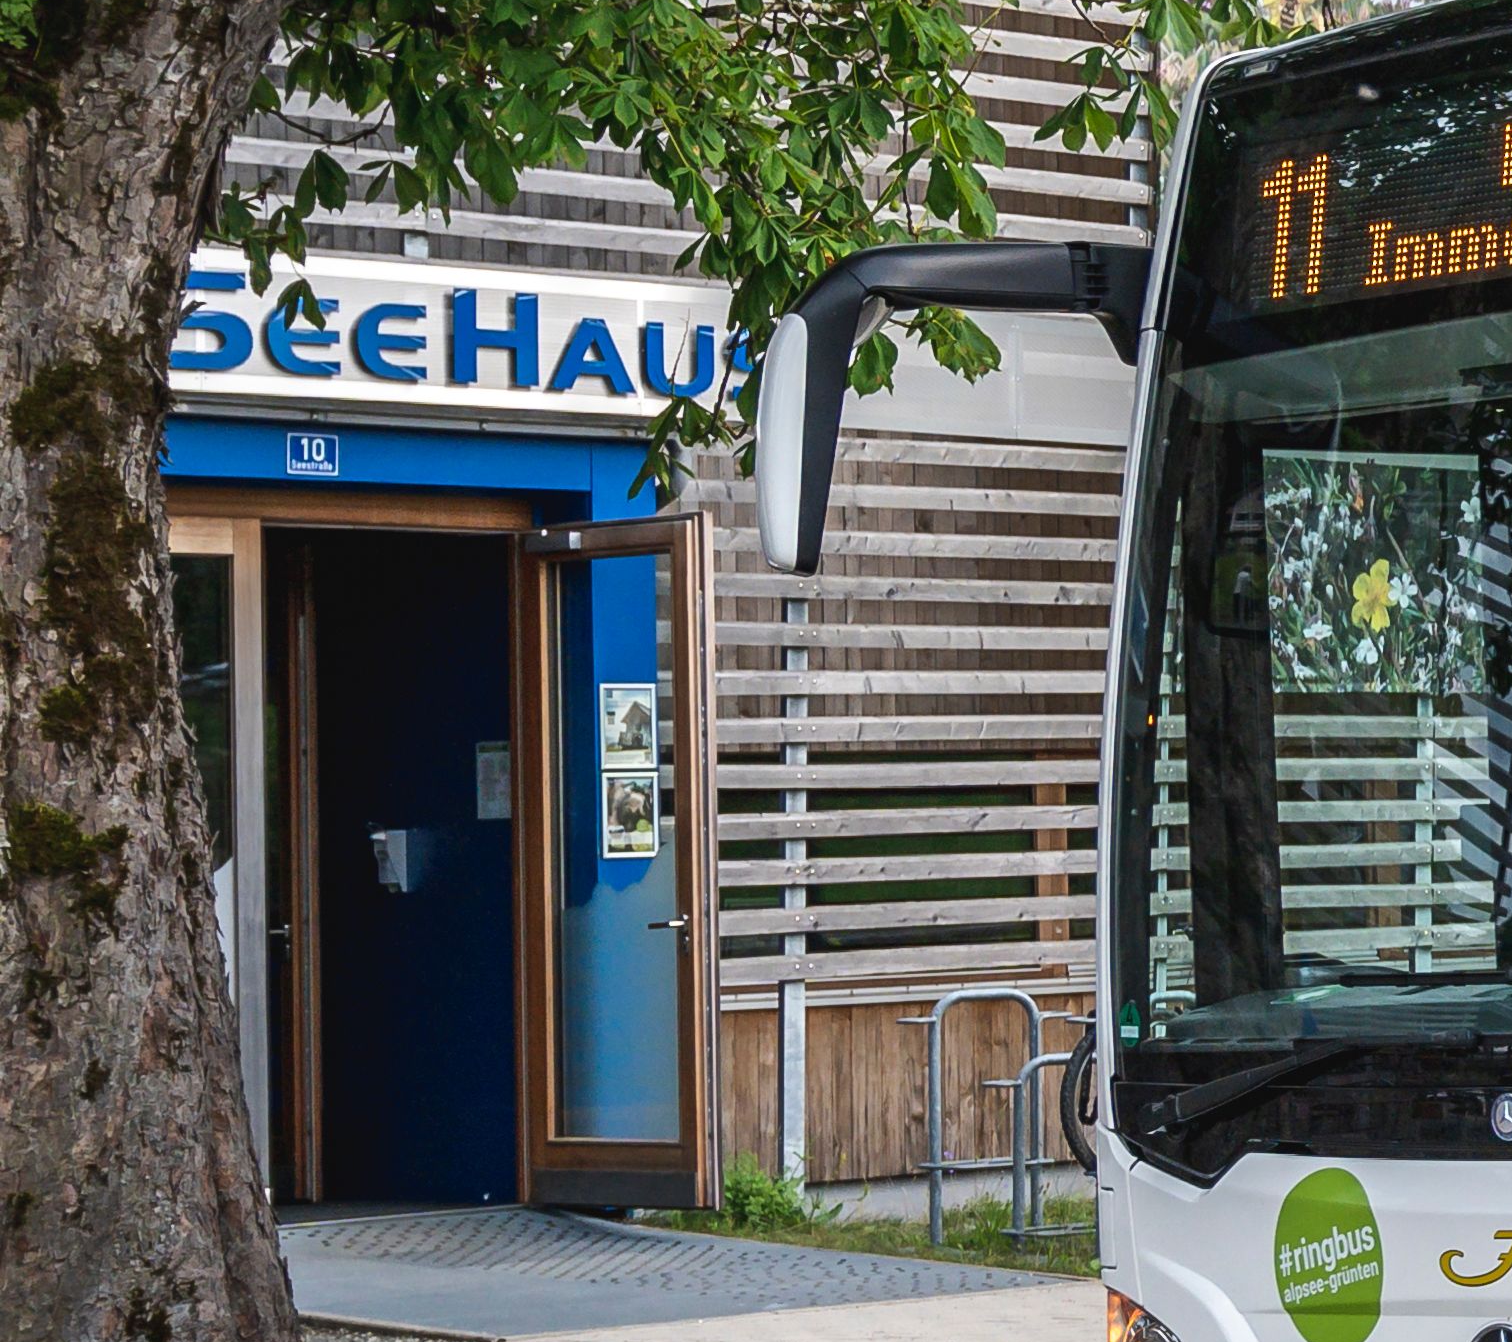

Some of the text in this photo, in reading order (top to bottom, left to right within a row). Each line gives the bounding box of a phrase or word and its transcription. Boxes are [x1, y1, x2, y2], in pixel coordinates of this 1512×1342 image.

[1262, 153, 1328, 299] 11
[301, 437, 325, 462] 10
[1279, 1221, 1376, 1278] #ringbus
[1283, 1260, 1380, 1304] alpsee-grünten
